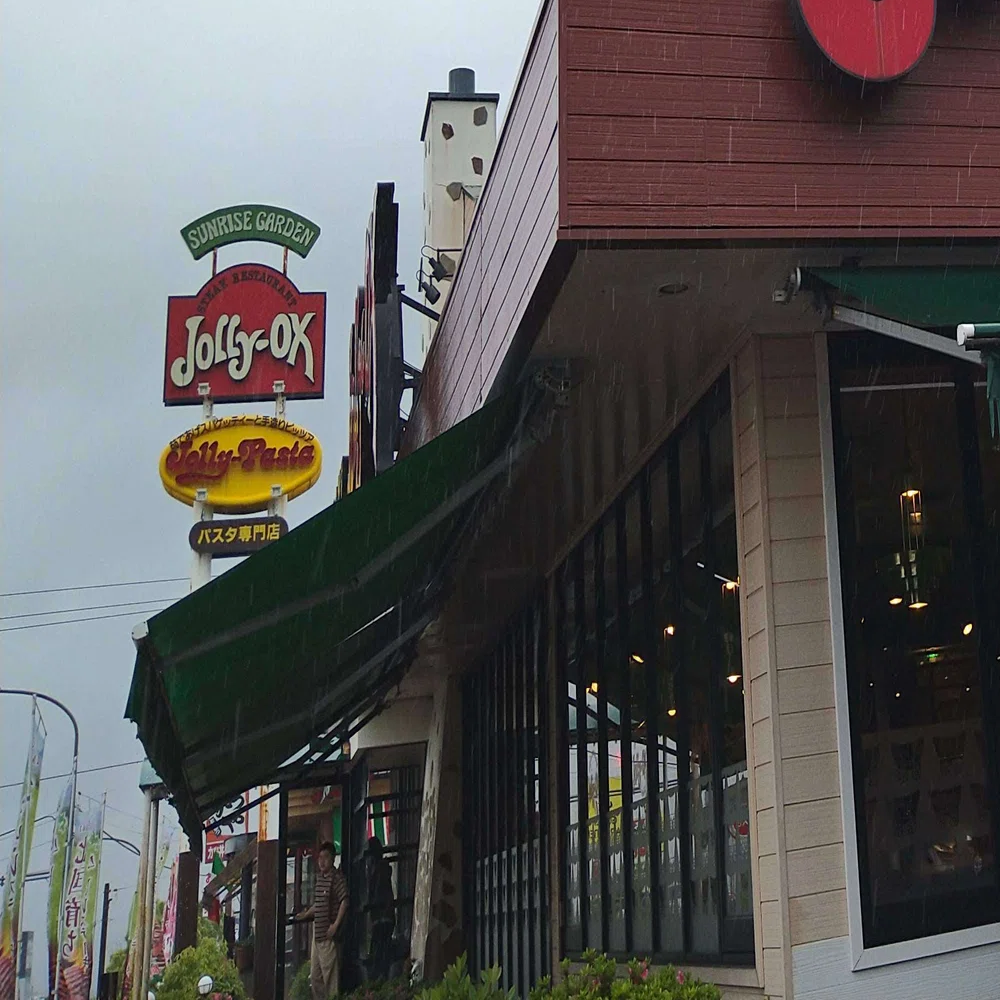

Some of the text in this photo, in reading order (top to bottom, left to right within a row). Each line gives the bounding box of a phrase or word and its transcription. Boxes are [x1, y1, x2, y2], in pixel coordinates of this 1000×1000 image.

[188, 211, 315, 249] SUNRISE GARDEN
[197, 269, 297, 313] STEAK RESTAURANT
[166, 438, 315, 484] Jolly-Pasta
[197, 523, 281, 544] パスタ専門店
